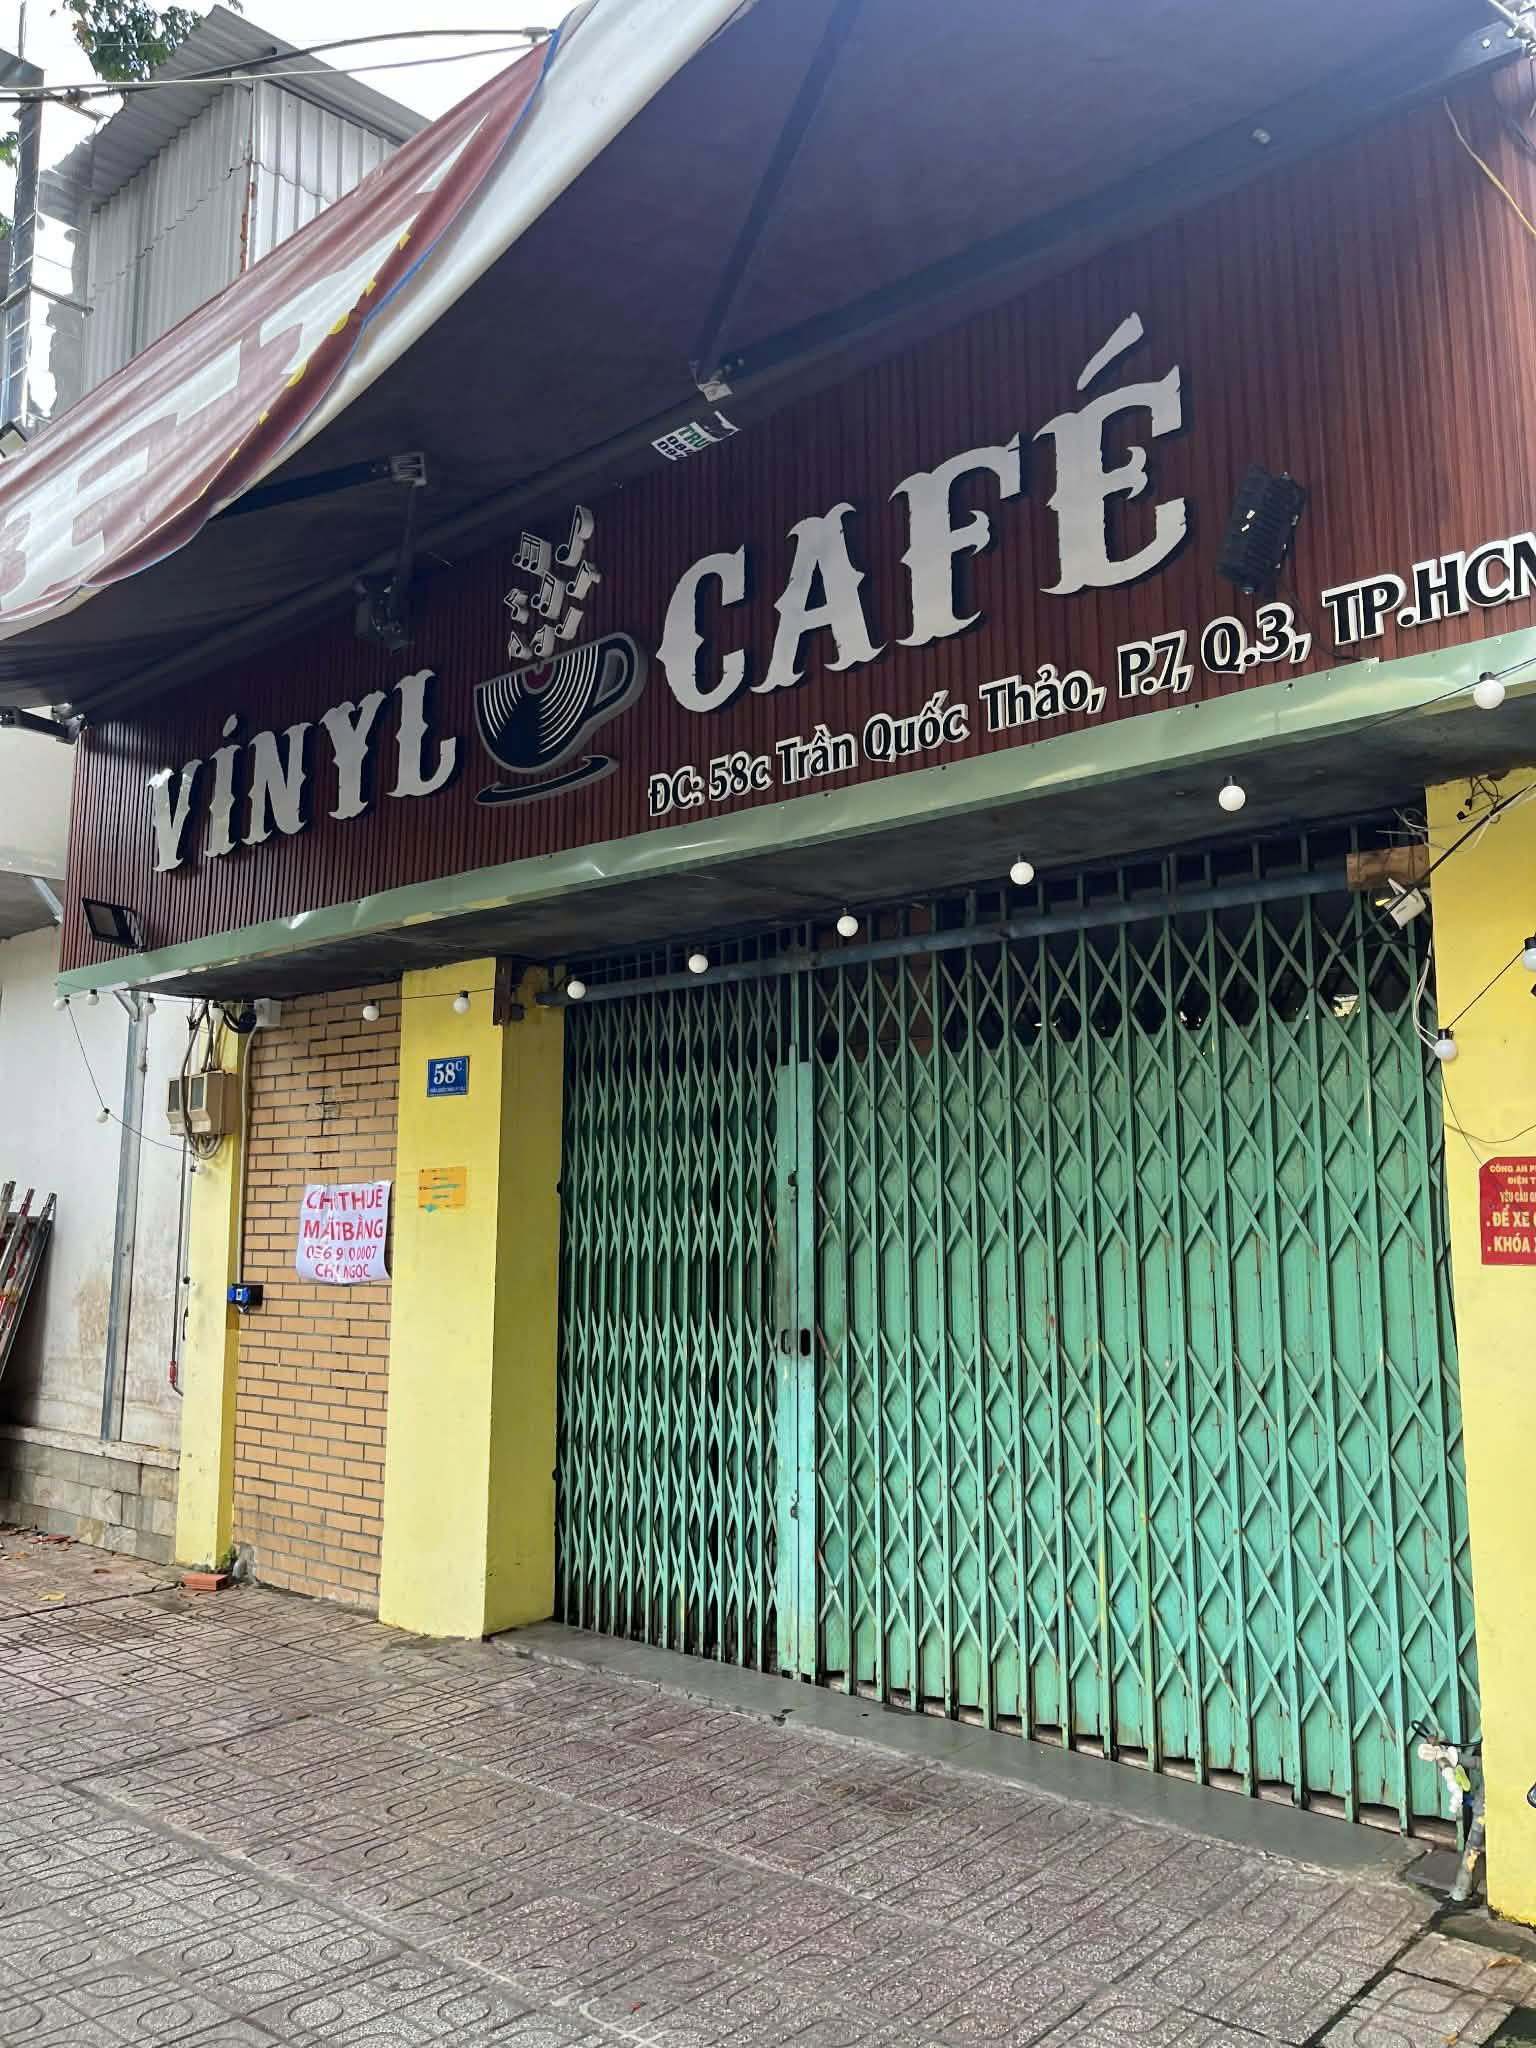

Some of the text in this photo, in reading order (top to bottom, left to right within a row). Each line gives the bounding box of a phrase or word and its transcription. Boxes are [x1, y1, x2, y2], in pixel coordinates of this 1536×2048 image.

[655, 312, 1187, 713] CAFÉ
[648, 766, 705, 816] ĐC:
[709, 751, 772, 801] 58c
[776, 724, 858, 785] Trần
[864, 690, 969, 763] Quốc
[979, 664, 1107, 732] Thảo,
[1117, 629, 1194, 699] P.7,
[1200, 602, 1312, 674] Q.3,
[338, 1184, 383, 1211] THUÊ
[1512, 1211, 1530, 1228] XE
